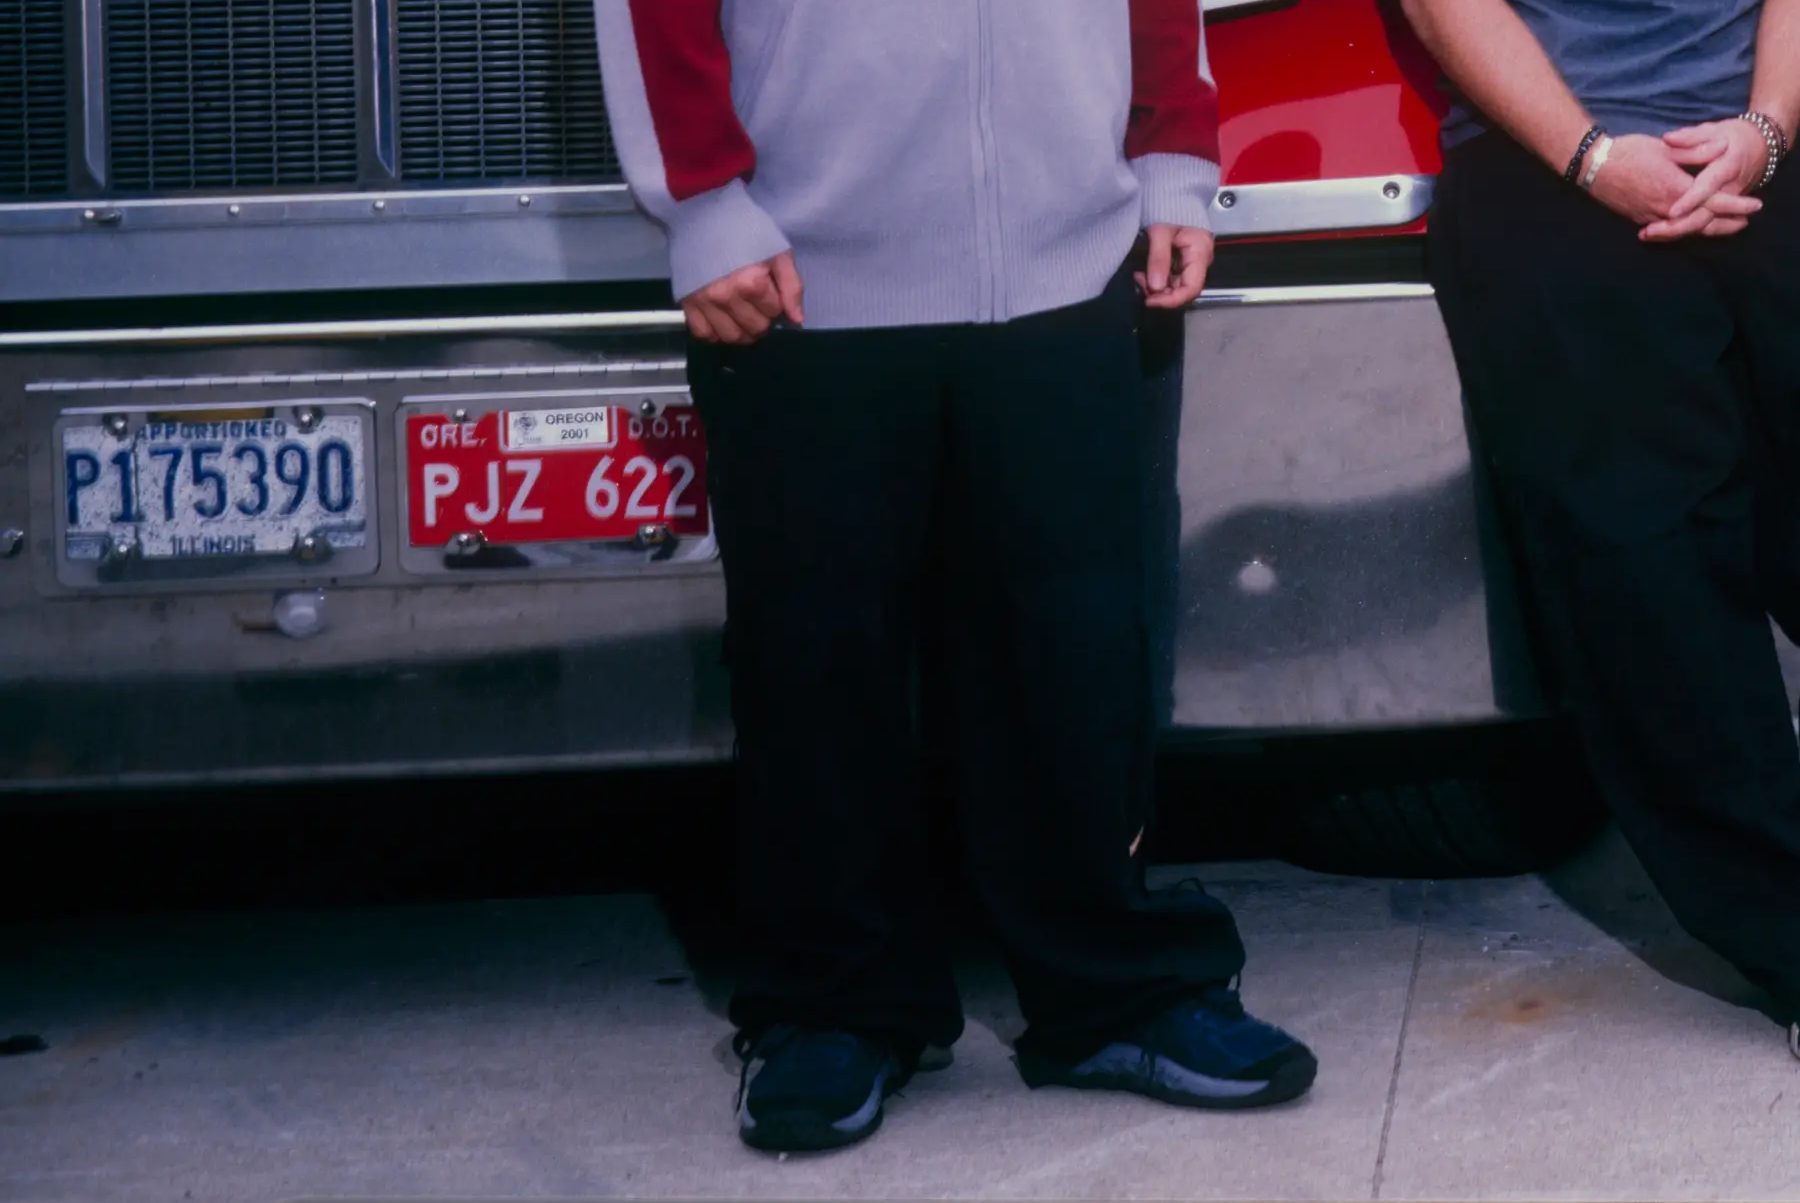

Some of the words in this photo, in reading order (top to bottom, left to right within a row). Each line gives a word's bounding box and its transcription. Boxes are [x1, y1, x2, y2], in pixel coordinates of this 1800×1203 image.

[545, 411, 604, 426] OREGON
[627, 414, 698, 440] D.O.T.
[560, 428, 589, 440] 2001
[65, 439, 354, 525] P175390
[423, 458, 545, 528] PJZ
[585, 455, 698, 520] 622
